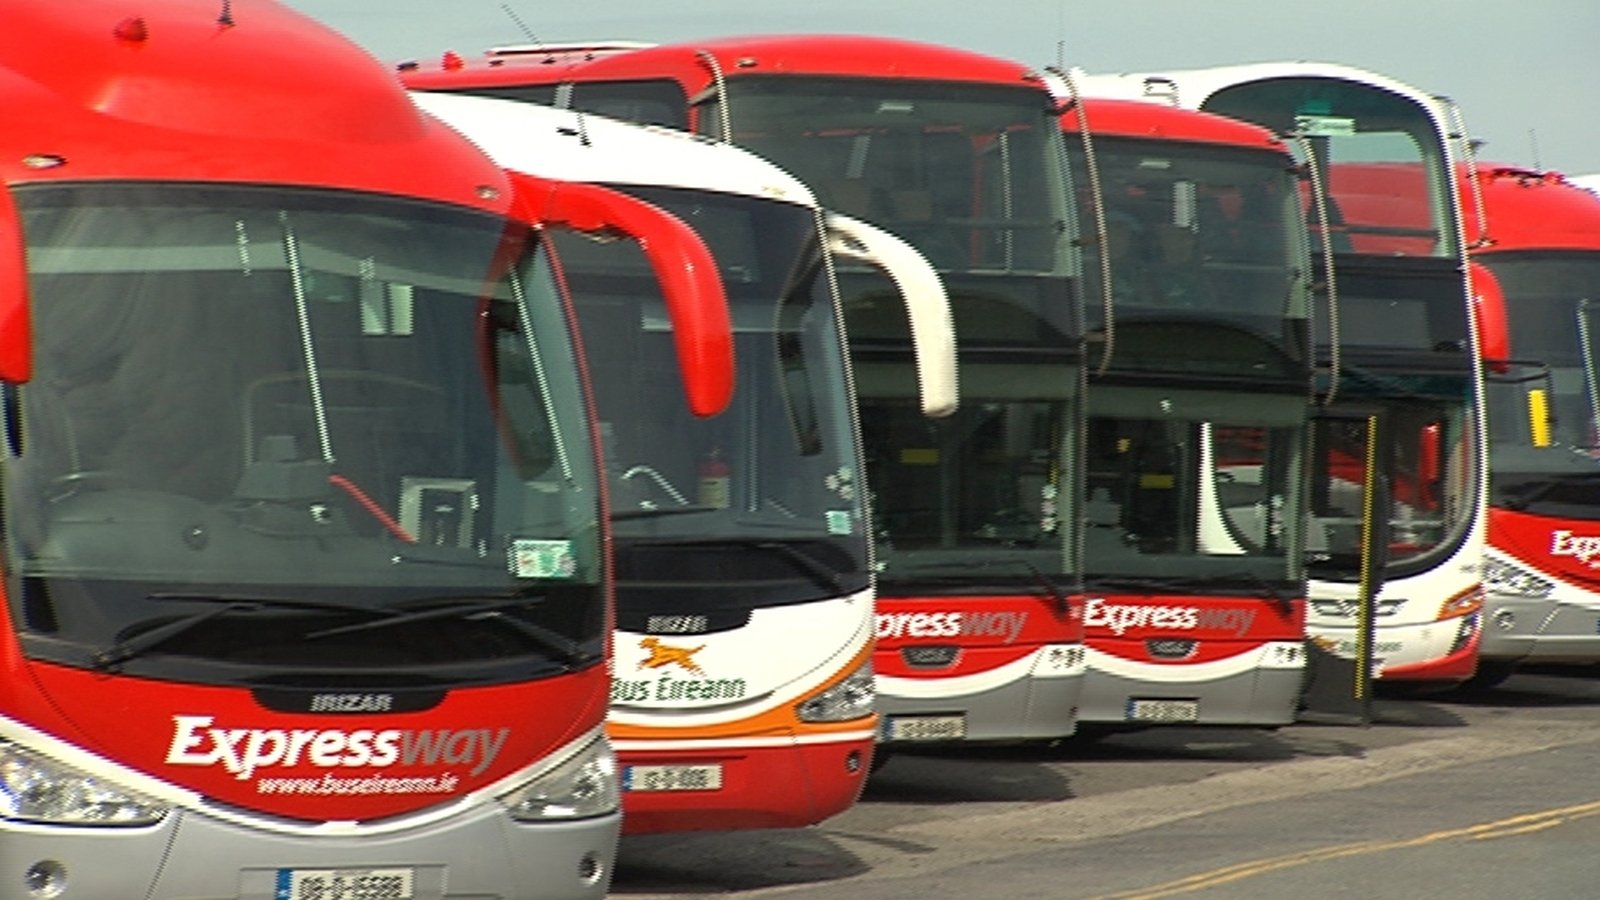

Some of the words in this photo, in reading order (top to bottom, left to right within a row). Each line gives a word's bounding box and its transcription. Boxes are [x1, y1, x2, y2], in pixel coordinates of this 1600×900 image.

[1082, 598, 1258, 637] Expressway
[309, 693, 394, 711] IRIZAR
[165, 714, 511, 780] Expressway
[257, 773, 460, 795] www.buseireann.ie
